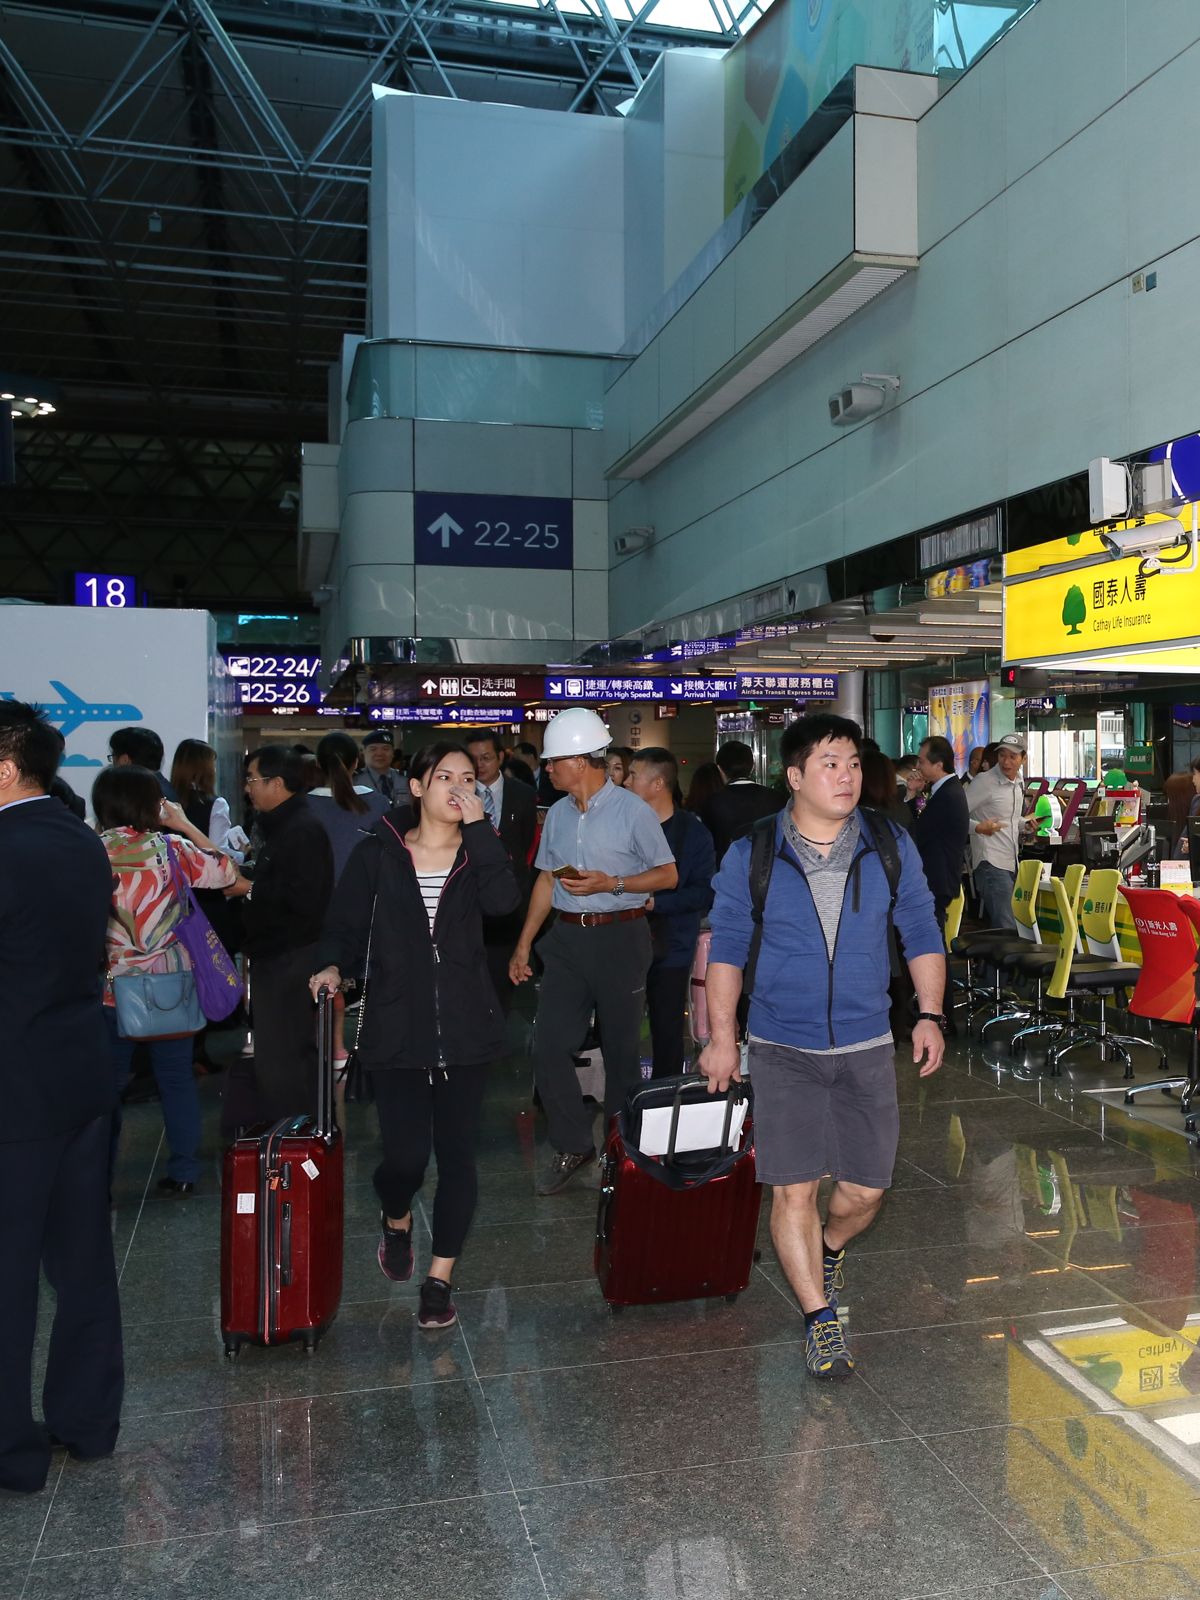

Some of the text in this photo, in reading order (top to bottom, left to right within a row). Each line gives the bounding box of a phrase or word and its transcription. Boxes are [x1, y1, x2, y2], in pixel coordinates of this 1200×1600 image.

[474, 521, 560, 549] 22-25
[85, 577, 126, 607] 18
[1093, 575, 1147, 610] 國泰人壽
[1093, 613, 1151, 632] Cathay Life Insurance
[251, 657, 321, 677] 22-24/
[482, 678, 516, 690] 洗手間
[585, 679, 654, 691] 捷運/轉乘高鐵
[741, 677, 834, 689] 海天聯運服務櫃台
[251, 683, 310, 703] 25-26
[614, 691, 629, 699] High
[631, 691, 650, 699] Speed
[787, 689, 810, 697] Express
